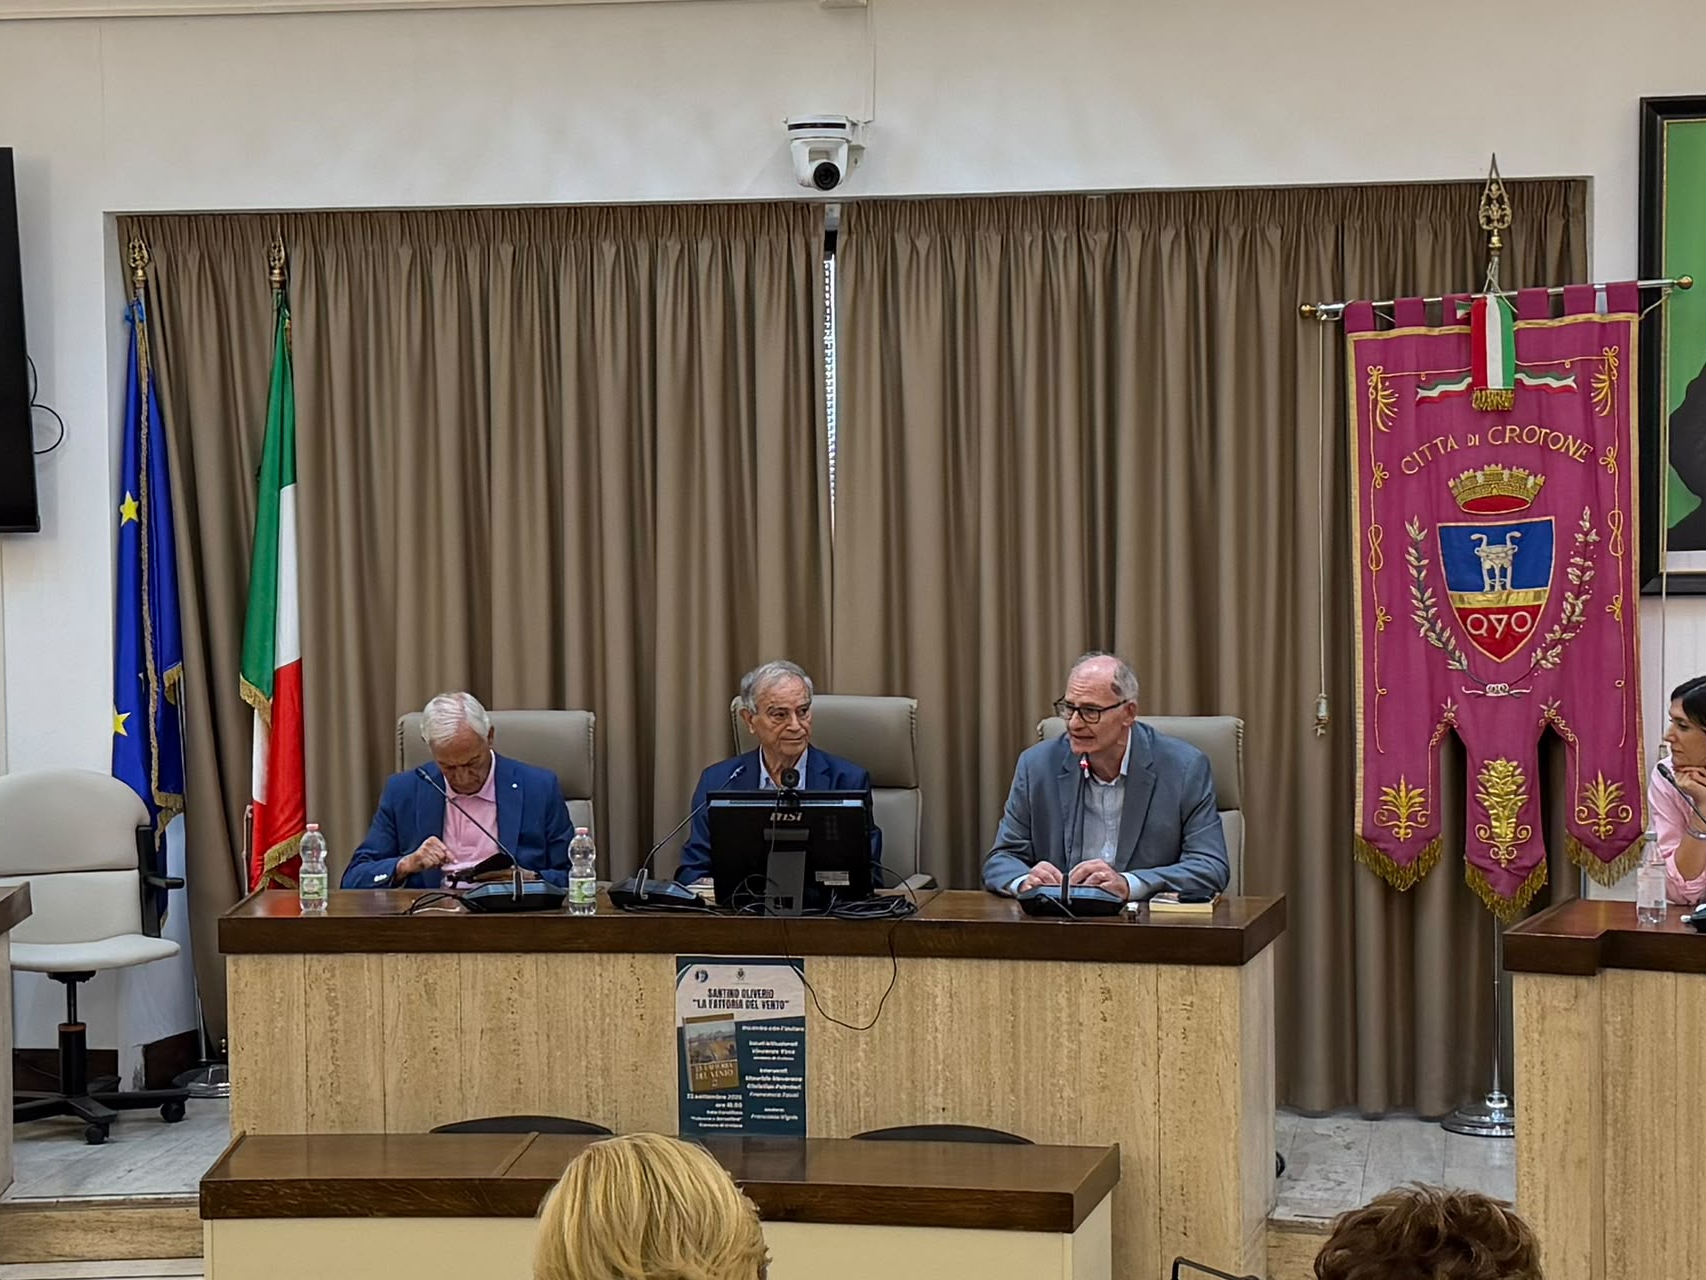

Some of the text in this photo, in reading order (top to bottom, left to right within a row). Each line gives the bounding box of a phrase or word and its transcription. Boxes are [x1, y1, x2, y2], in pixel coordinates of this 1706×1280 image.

[1467, 433, 1479, 447] DI
[1487, 425, 1594, 463] CROTONE
[745, 999, 759, 1009] DEL
